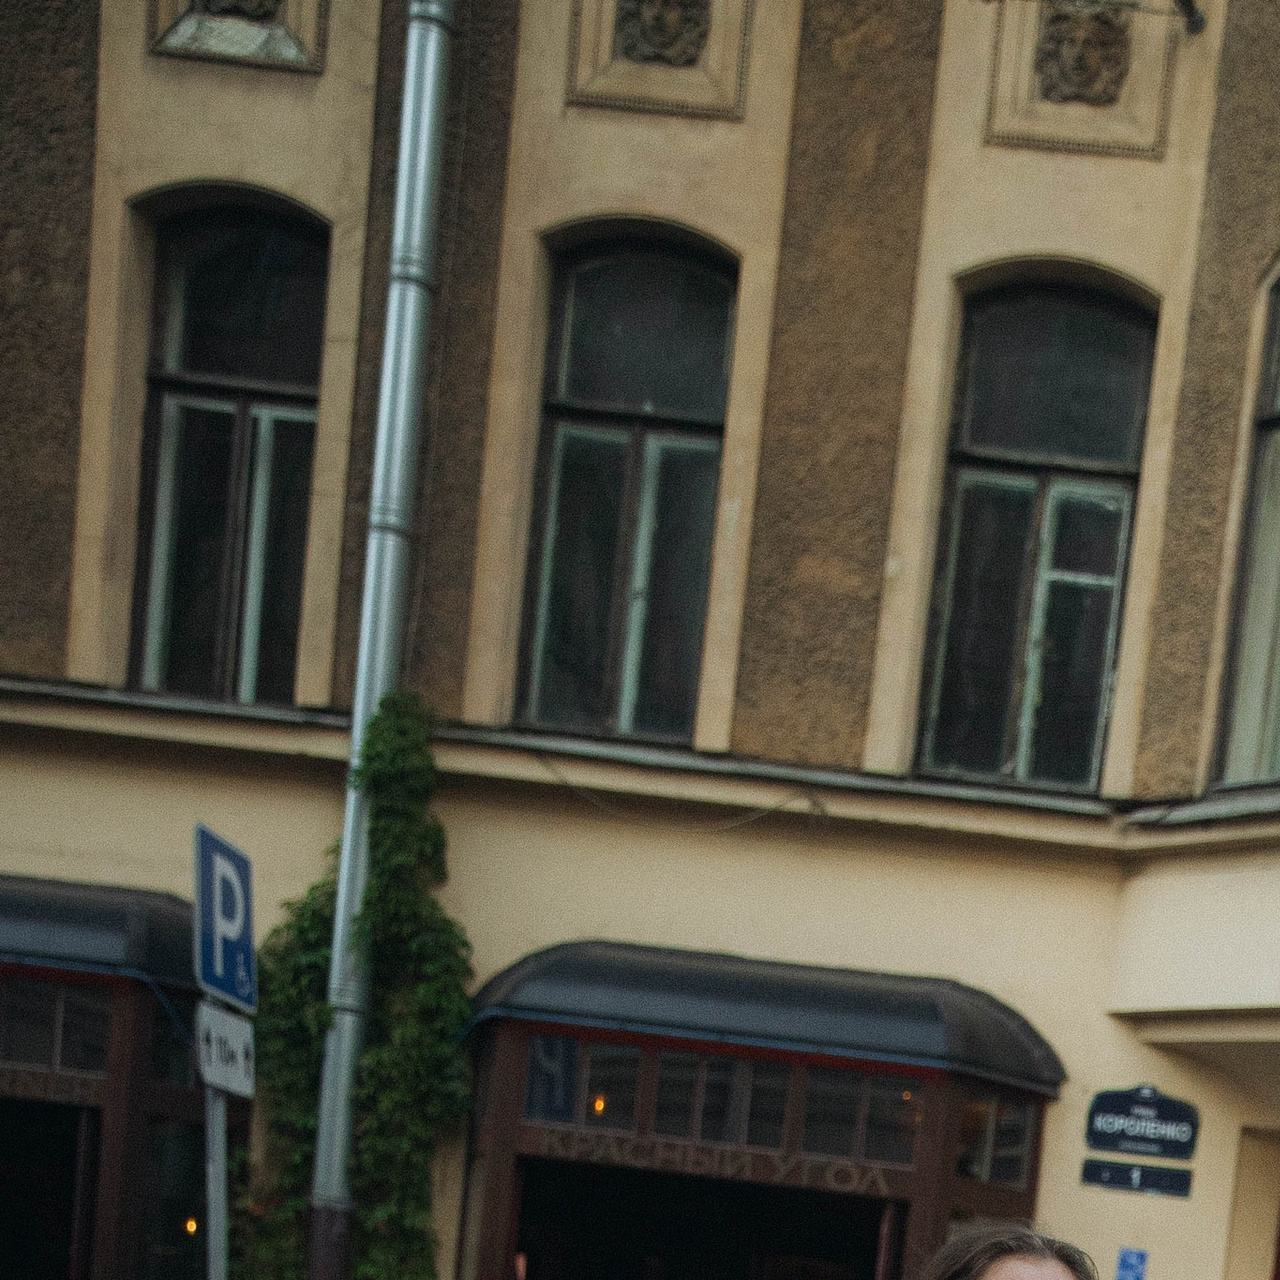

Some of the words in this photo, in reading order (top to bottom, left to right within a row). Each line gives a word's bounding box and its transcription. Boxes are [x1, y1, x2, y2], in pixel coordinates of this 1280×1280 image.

[213, 854, 245, 978] P
[1092, 1112, 1194, 1143] КОРОЛЕНКО
[770, 1153, 890, 1197] УГОЛ
